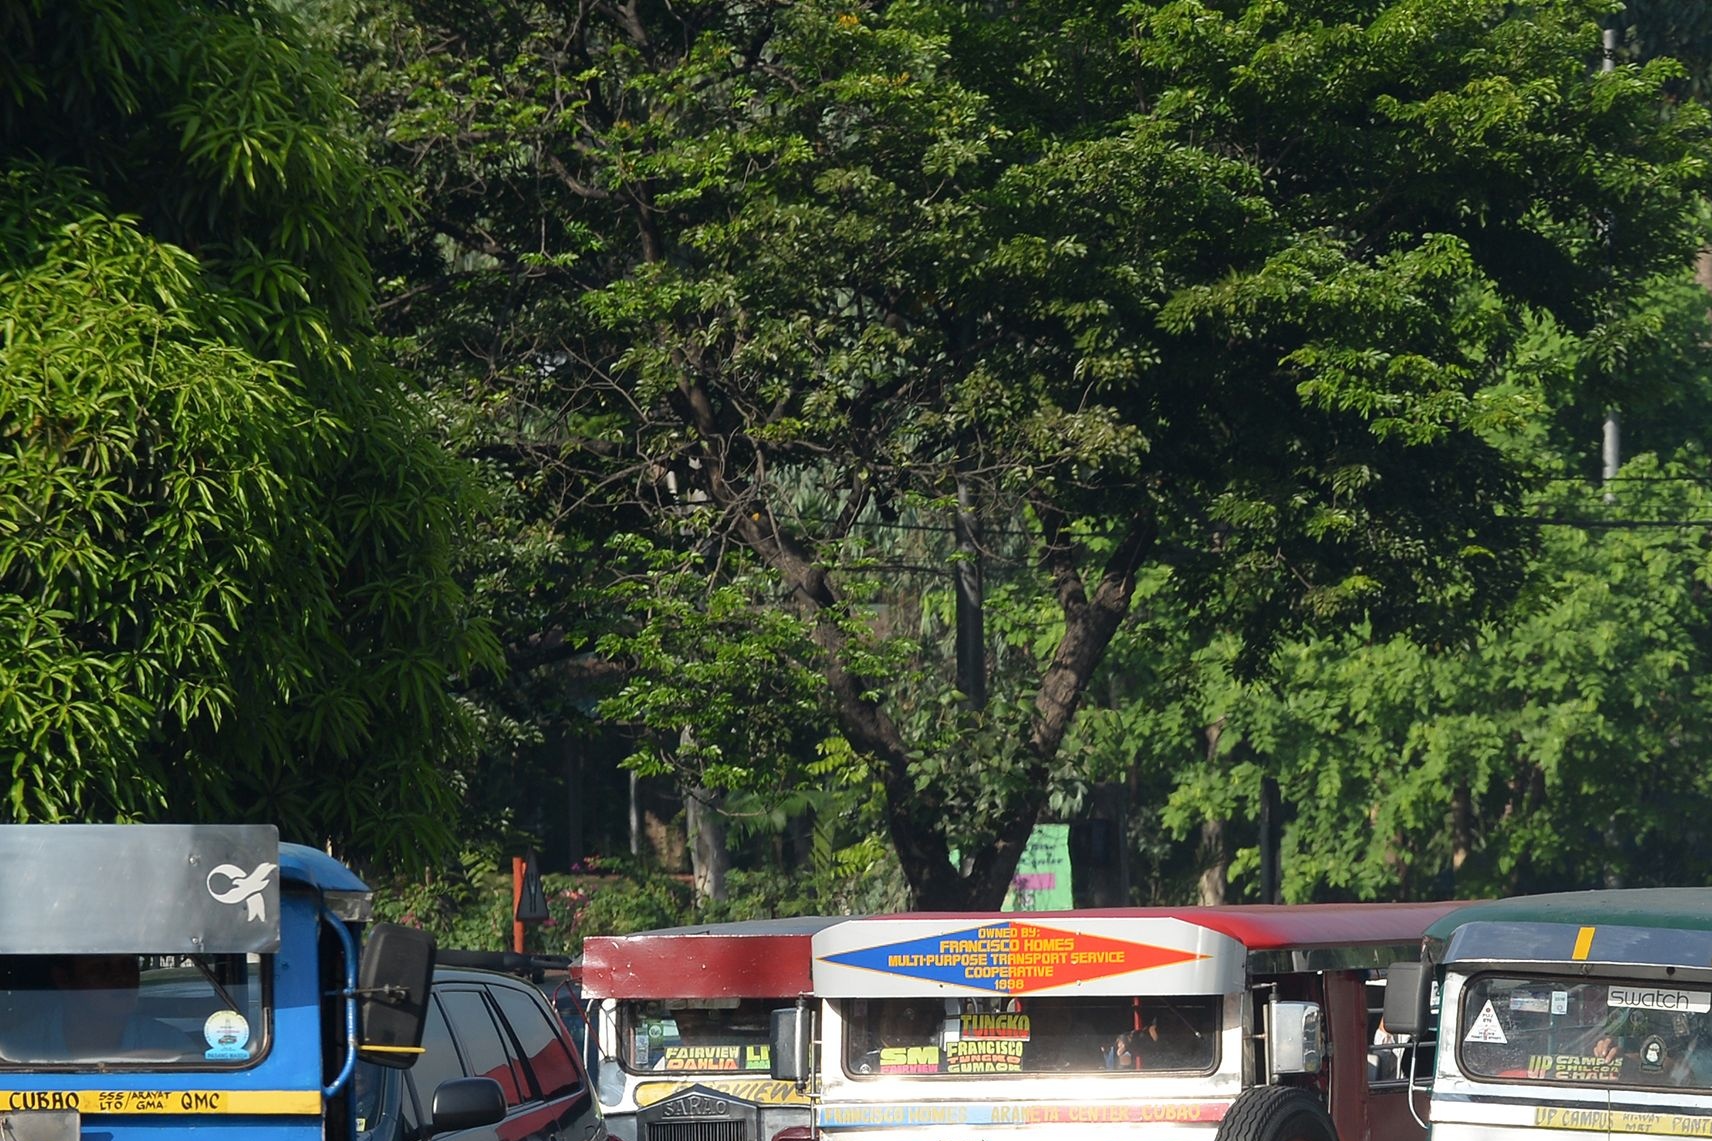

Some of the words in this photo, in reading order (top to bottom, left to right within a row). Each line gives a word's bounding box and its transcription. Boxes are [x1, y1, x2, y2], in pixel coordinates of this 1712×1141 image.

[978, 927, 1016, 939] OWNED
[1021, 927, 1040, 938] BY:
[940, 940, 1020, 953] FRANCISCO
[1024, 938, 1074, 951] HOMES
[888, 954, 988, 967] MULTI-PURPOSE
[991, 952, 1067, 965] TRANSPORT
[1070, 951, 1125, 964] SERVICE
[965, 966, 1053, 979] COOPERATIVE
[994, 979, 1025, 990] 1998
[1611, 990, 1689, 1009] swatch
[665, 1047, 740, 1059] FAIRVIEW
[880, 1047, 939, 1065] SM
[946, 1042, 1023, 1057] FRANCISCO
[667, 1058, 738, 1070] DAHLIA
[948, 1055, 1021, 1064] TUNGKO
[880, 1064, 938, 1073] FAIRVIEW
[1528, 1056, 1553, 1079] UP
[9, 1092, 79, 1110] CUBAO
[99, 1092, 125, 1101] SSS
[132, 1092, 171, 1100] ARAYAT
[181, 1092, 220, 1110] QMC
[100, 1101, 123, 1110] LTO
[136, 1101, 164, 1110] GMA
[664, 1096, 727, 1116] SARAO
[825, 1107, 904, 1123] FRANCISCO
[908, 1105, 967, 1122] HOMES
[1068, 1105, 1130, 1120] CENTER
[1142, 1104, 1201, 1120] CUBAO
[1535, 1107, 1556, 1125] UP
[1561, 1111, 1614, 1129] CAMPUS
